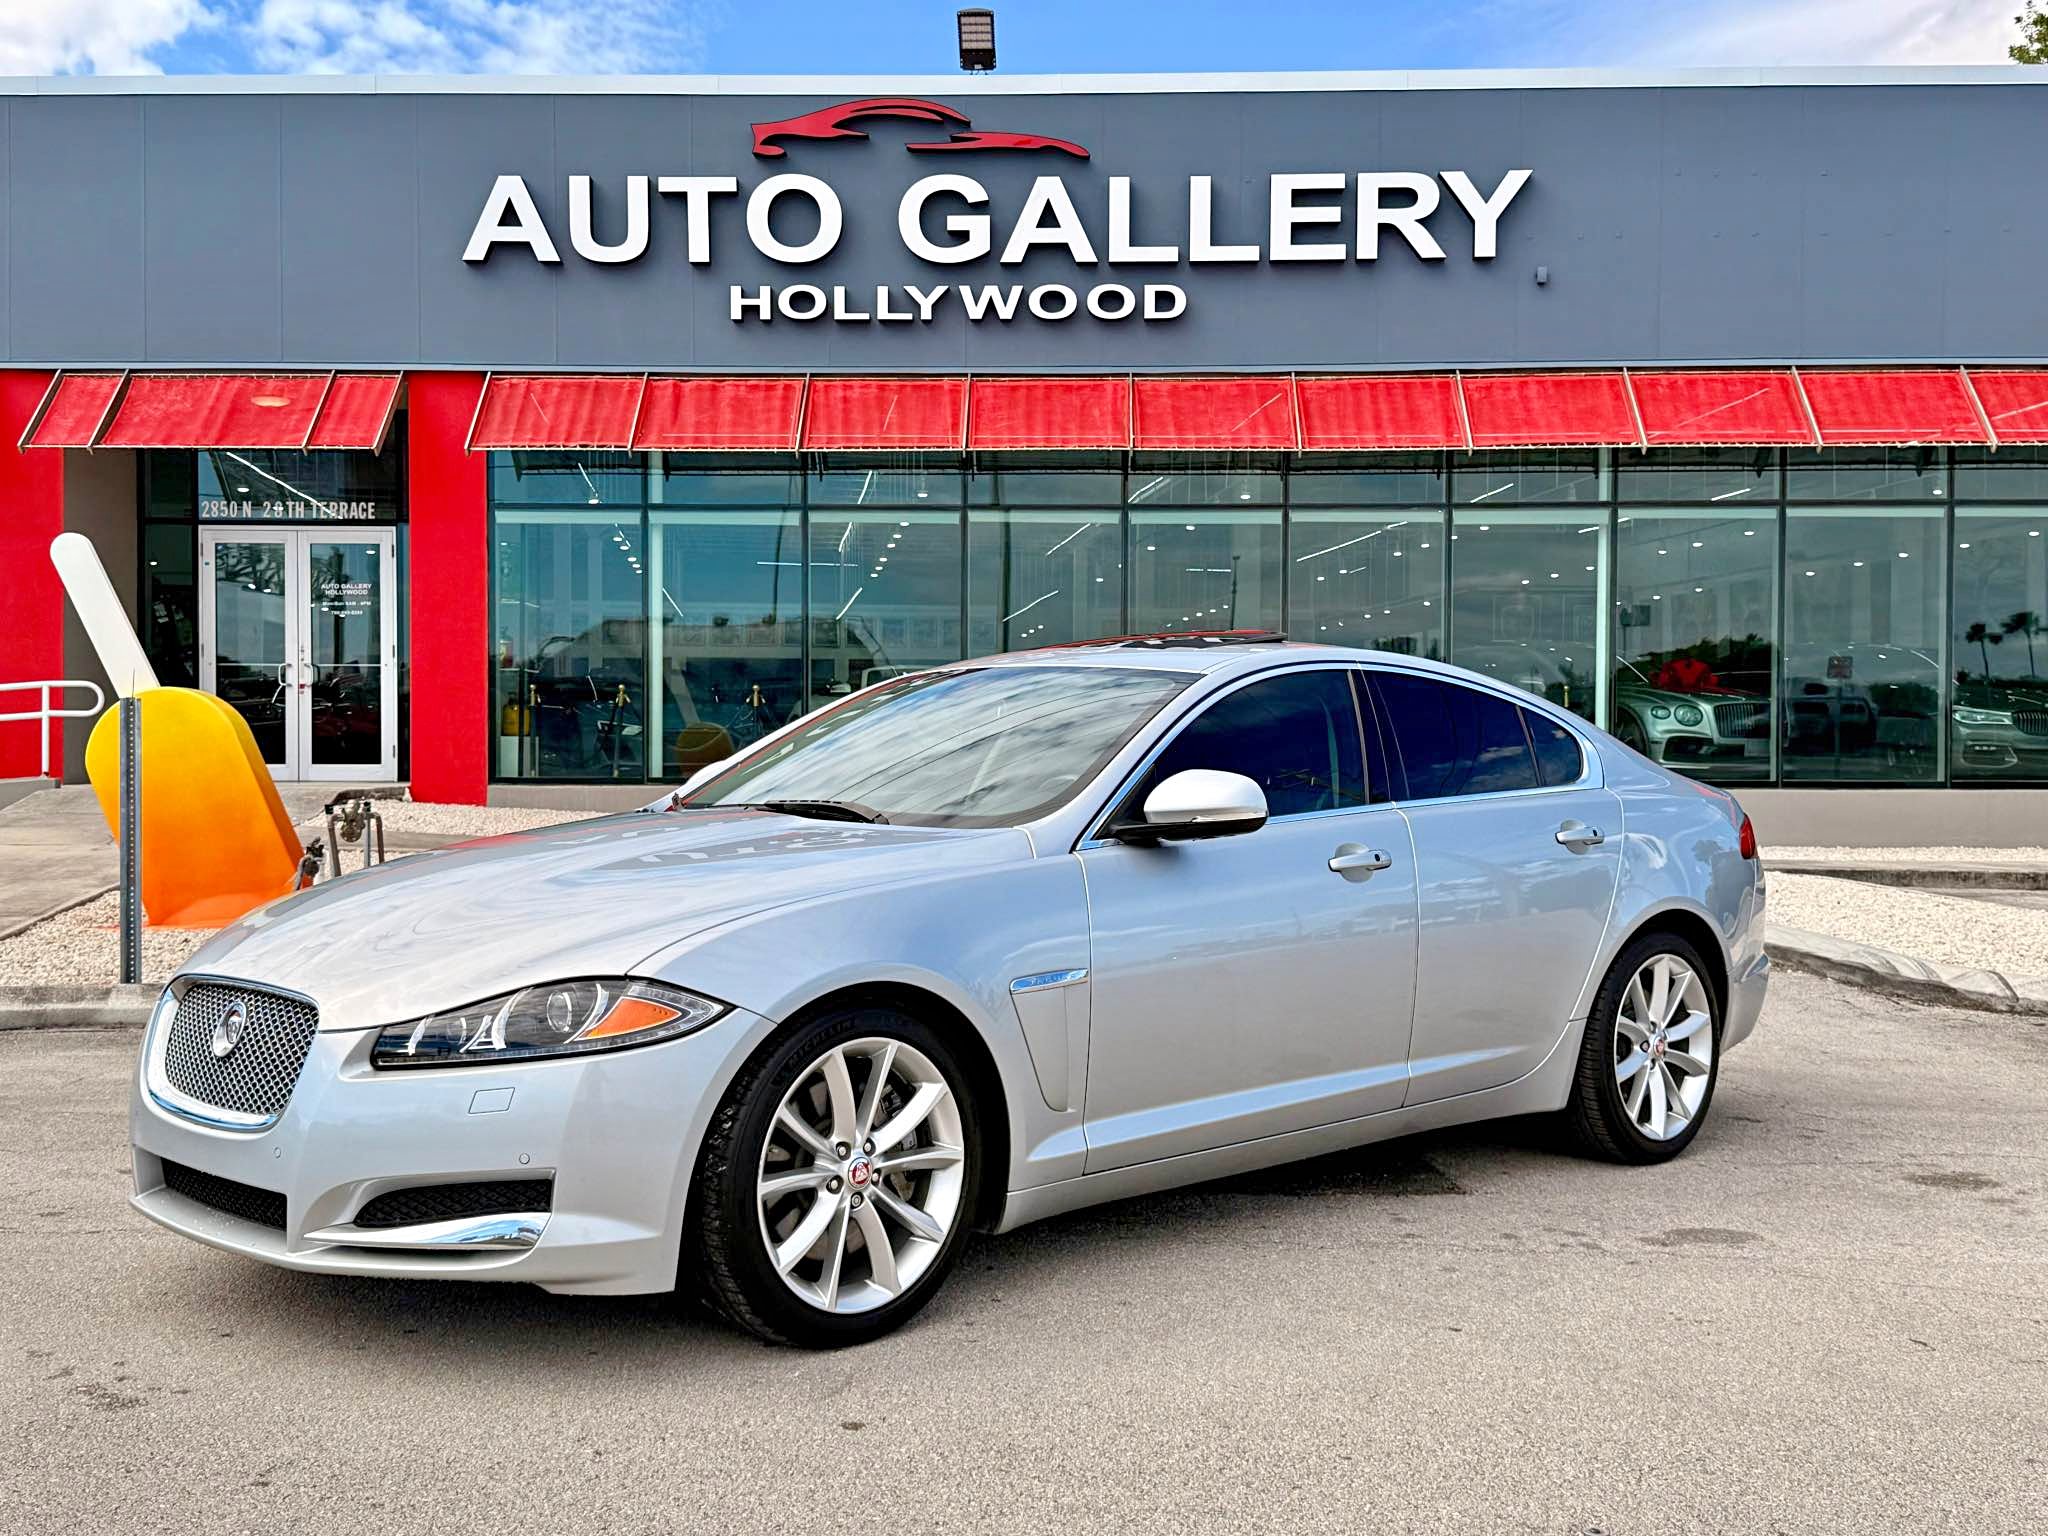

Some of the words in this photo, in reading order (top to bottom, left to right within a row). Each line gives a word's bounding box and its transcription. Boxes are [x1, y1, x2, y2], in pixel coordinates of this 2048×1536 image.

[462, 173, 843, 264] AUTO
[898, 168, 1533, 264] GALLERY
[729, 283, 1188, 322] HOLLYWOOD
[201, 501, 238, 518] 2850
[242, 501, 252, 518] N
[310, 501, 376, 520] TERRACE
